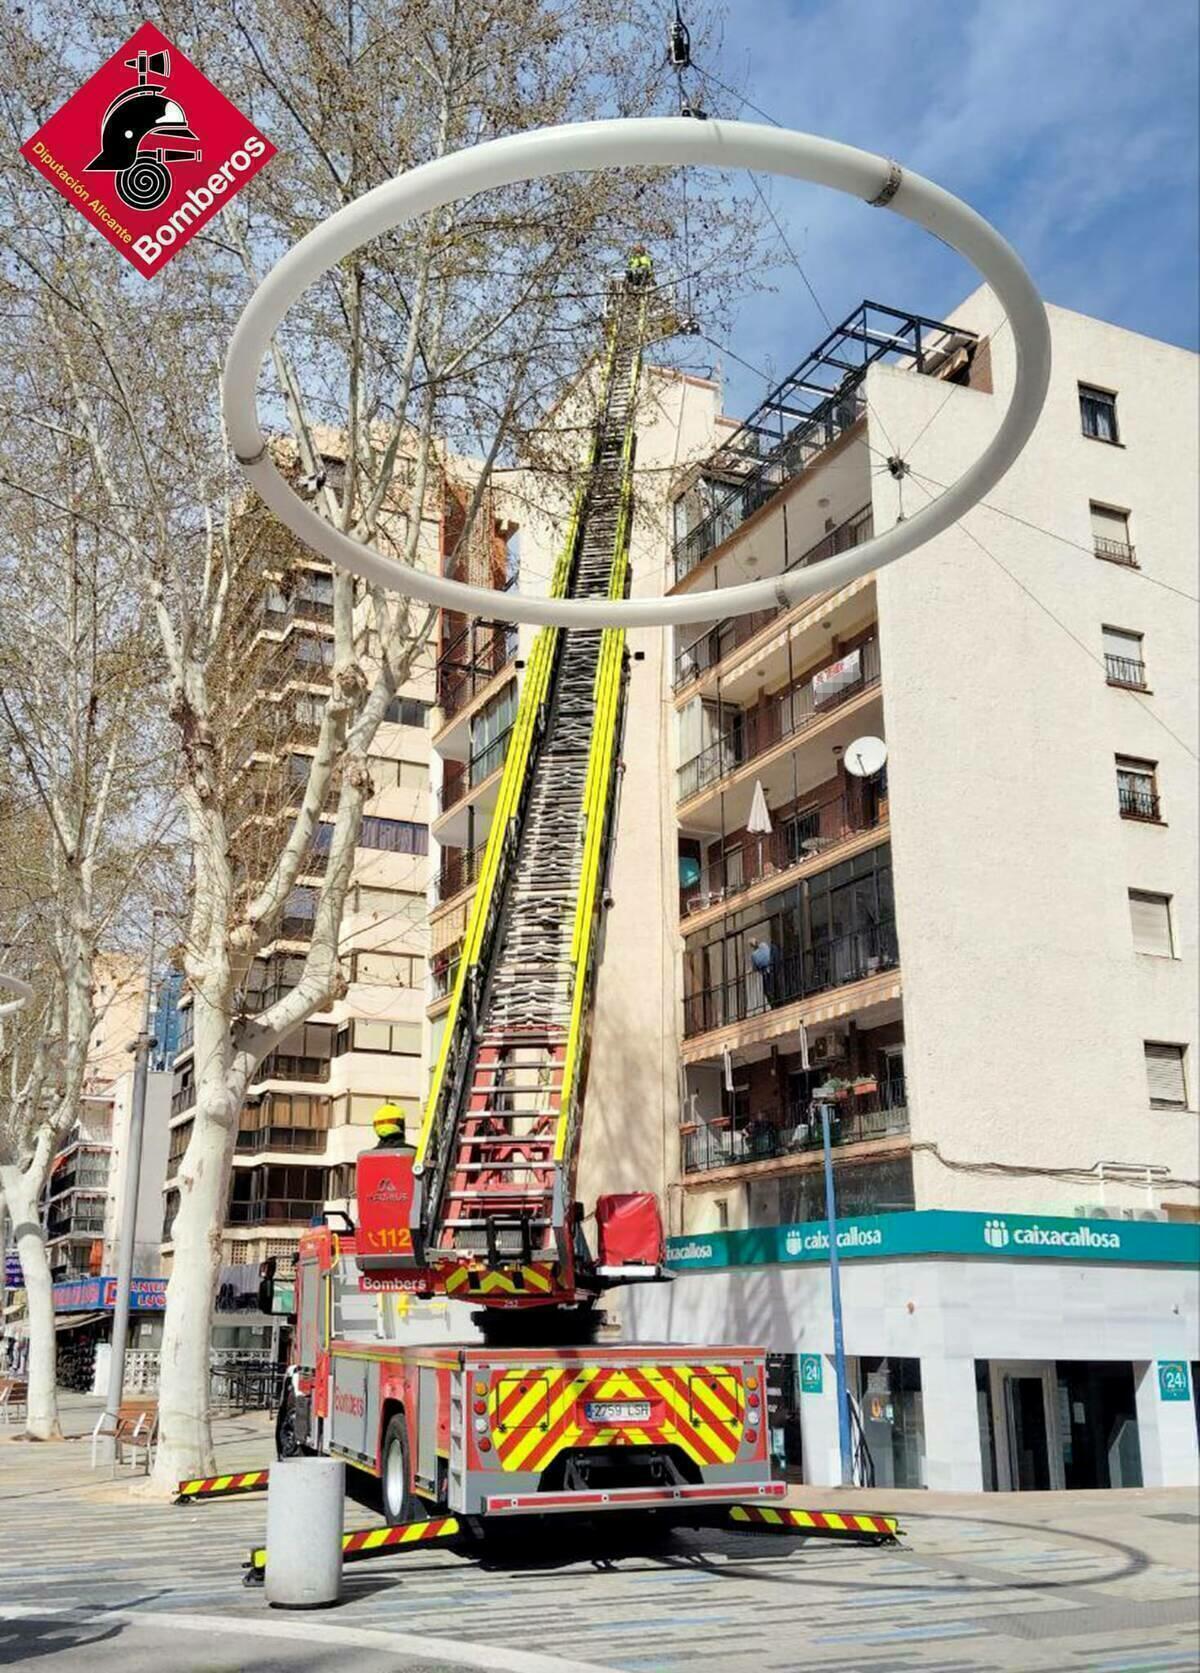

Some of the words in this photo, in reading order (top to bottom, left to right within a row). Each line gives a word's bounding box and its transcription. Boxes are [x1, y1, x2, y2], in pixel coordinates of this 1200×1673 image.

[377, 1228, 412, 1247] 112
[804, 1226, 882, 1250] caixcallosa
[1013, 1224, 1120, 1248] caixacallosa
[666, 1242, 712, 1261] ixacallosa
[363, 1277, 427, 1291] Bombers
[594, 1403, 623, 1418] 2759
